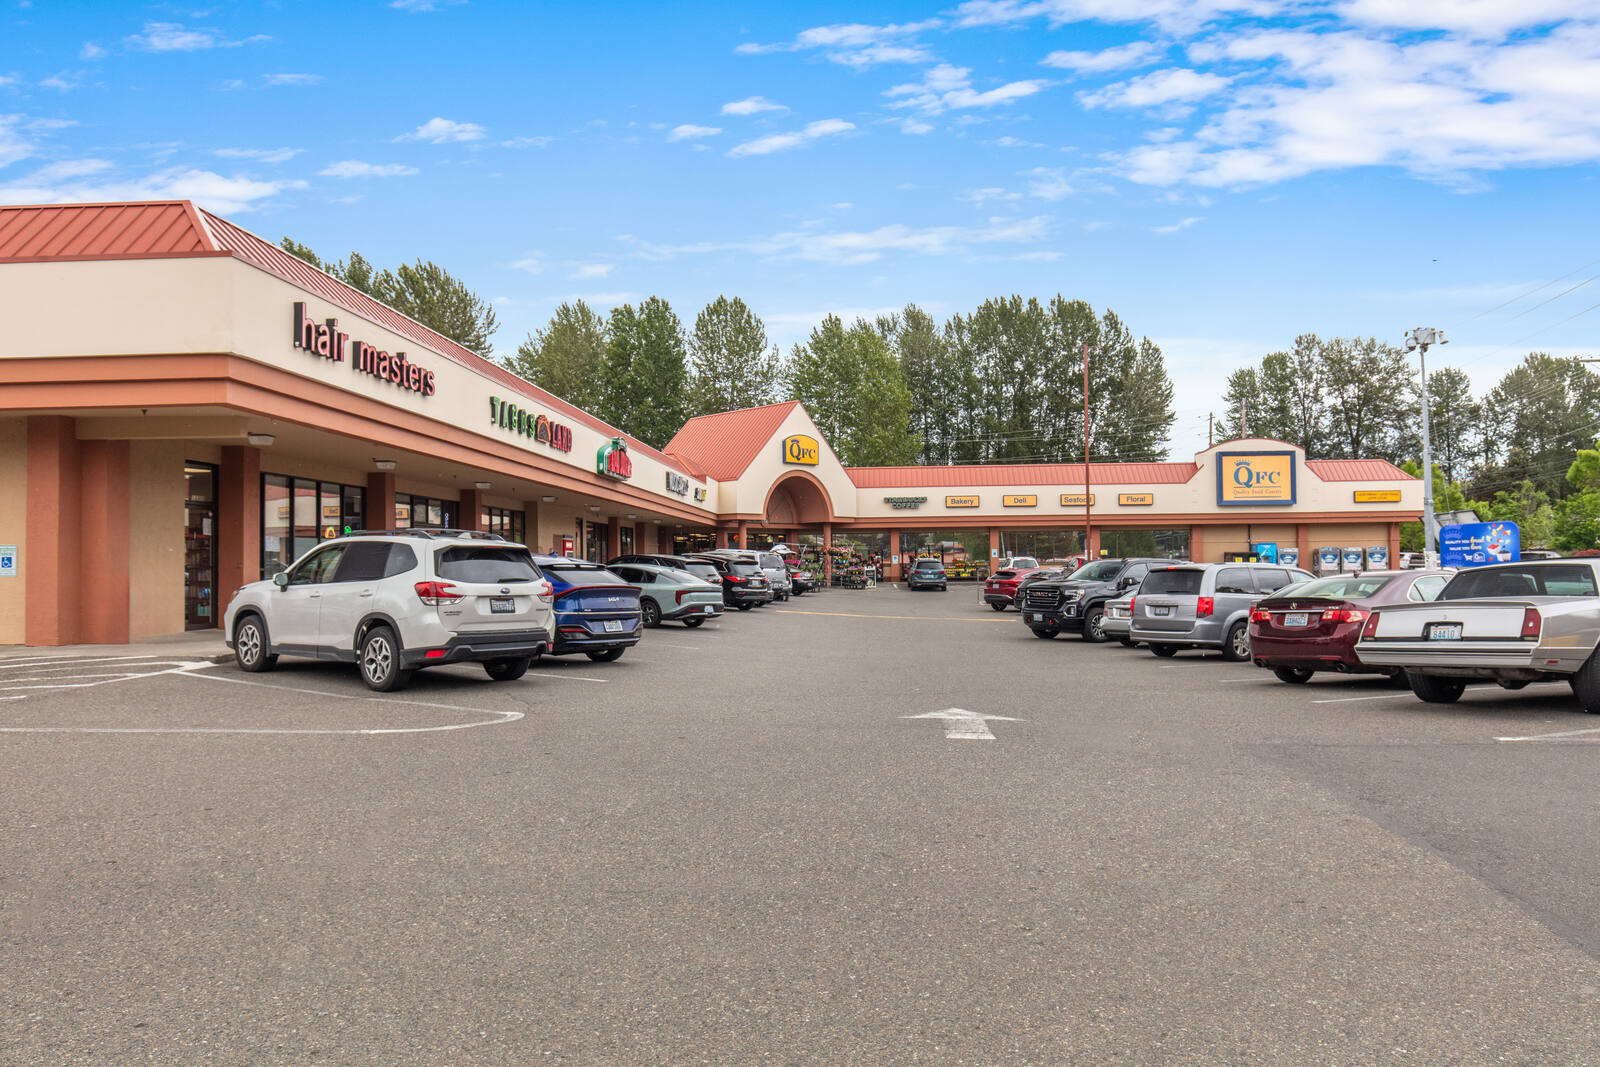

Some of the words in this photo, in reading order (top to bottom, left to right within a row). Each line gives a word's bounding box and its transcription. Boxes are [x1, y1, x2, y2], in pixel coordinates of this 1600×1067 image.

[293, 301, 349, 362] hair
[352, 340, 436, 397] masters
[490, 396, 536, 438] TACOS
[789, 442, 816, 461] QFC
[1233, 466, 1281, 488] QFC
[950, 497, 974, 507] Bakery
[1013, 496, 1027, 504] Deli
[1126, 495, 1146, 503] Floral
